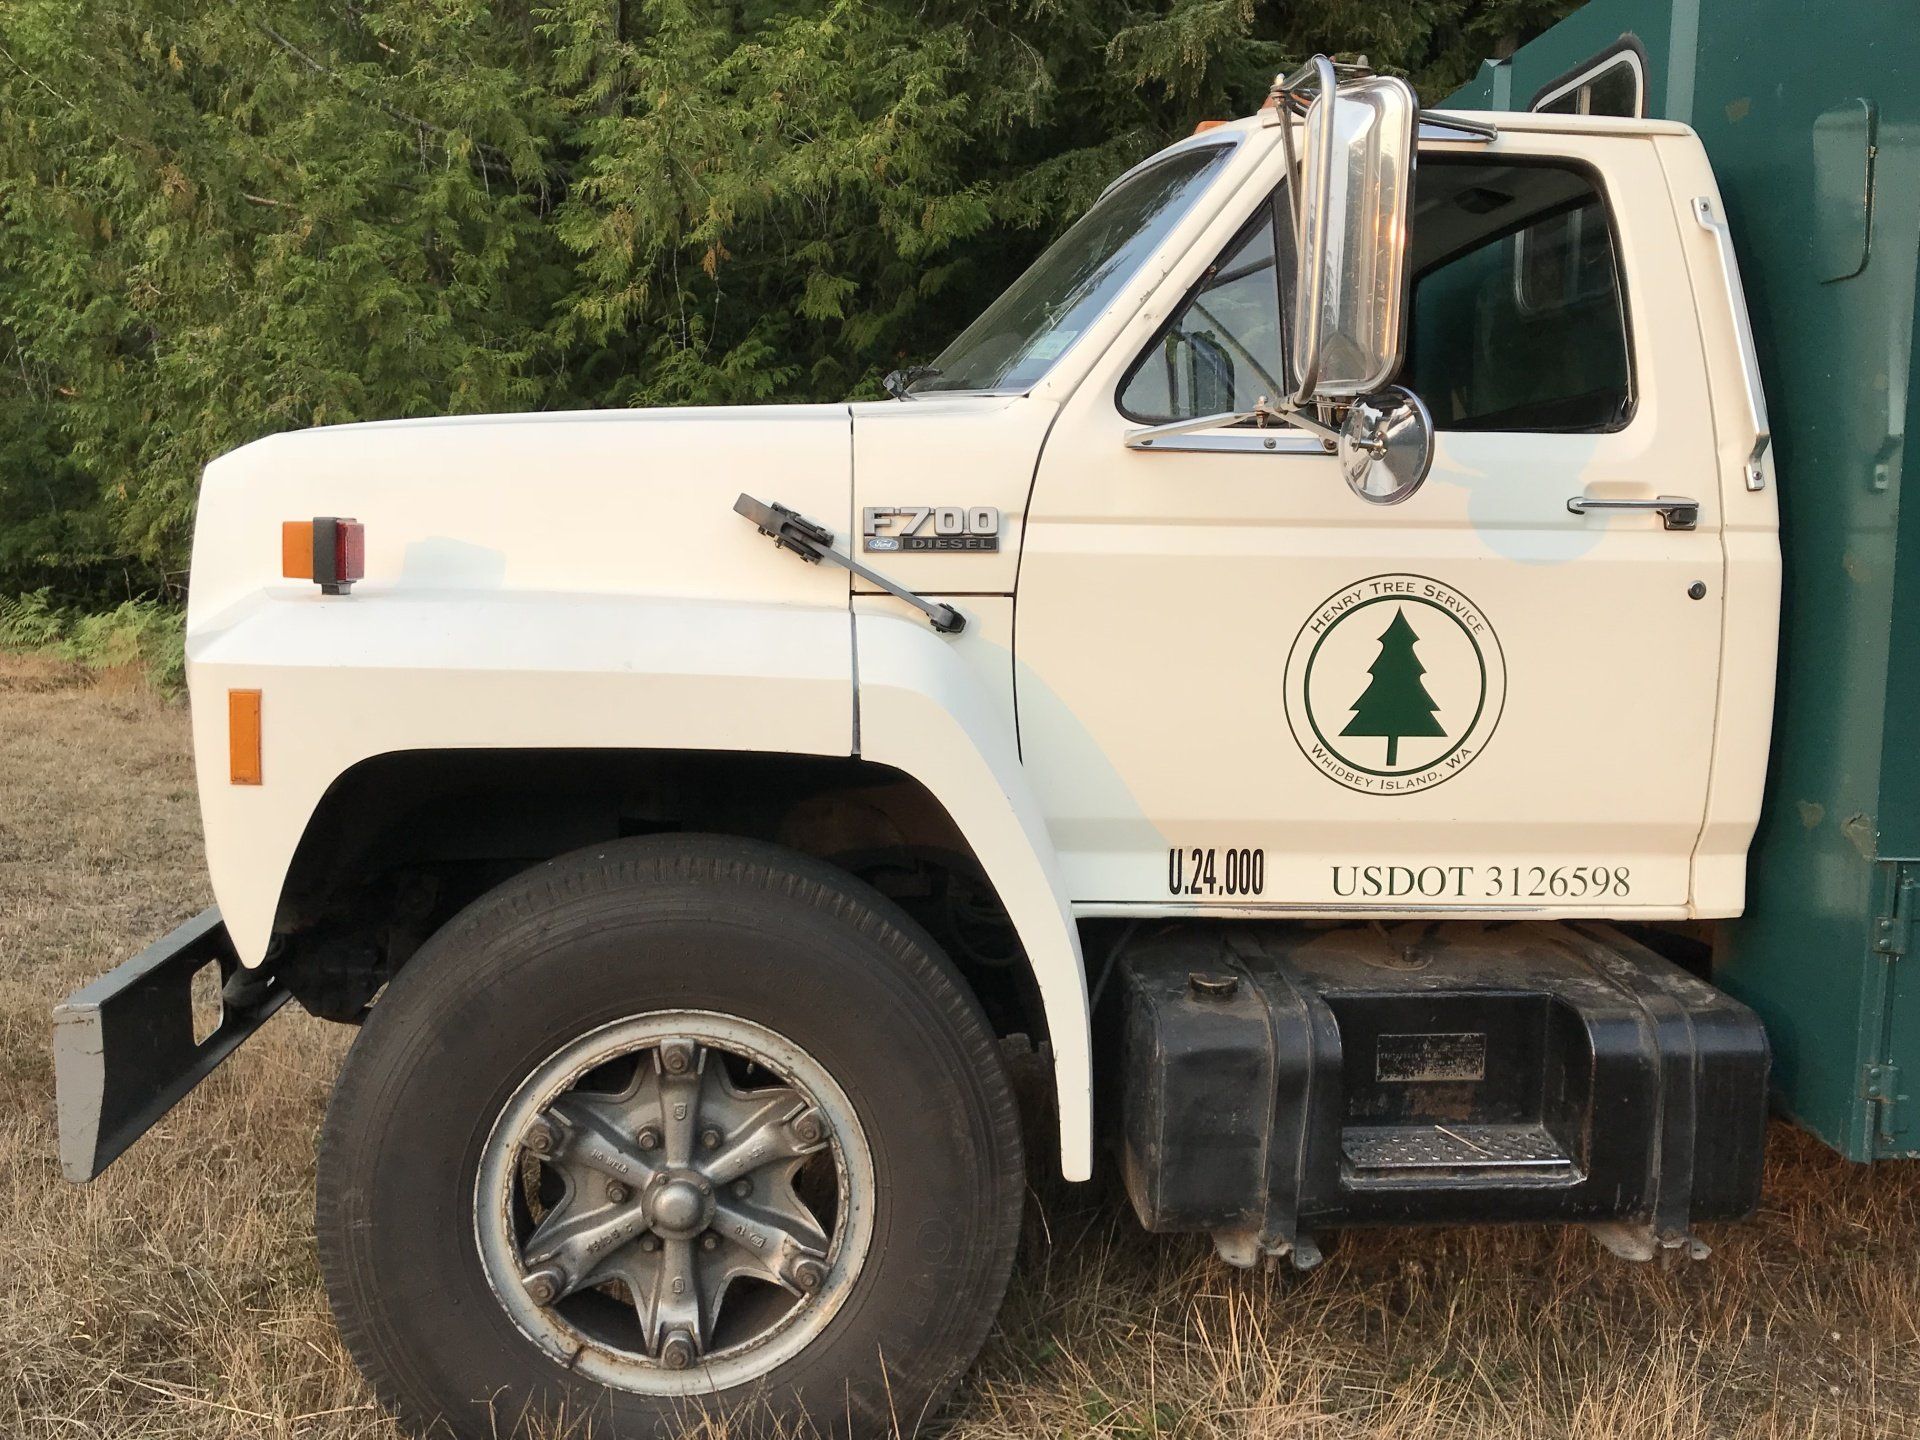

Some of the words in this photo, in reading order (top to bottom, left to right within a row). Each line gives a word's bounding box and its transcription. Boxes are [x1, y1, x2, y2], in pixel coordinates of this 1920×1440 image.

[863, 506, 998, 536] F700
[912, 539, 992, 549] DIESEL
[1310, 589, 1363, 635] HENRY
[1369, 581, 1416, 595] TREE
[1423, 584, 1485, 636] SERVICE
[1311, 743, 1374, 788] WHIDBEY
[1380, 771, 1444, 790] ISLAND,
[1445, 748, 1473, 769] WA
[1330, 865, 1475, 897] USDOT
[1485, 866, 1631, 897] 3126598
